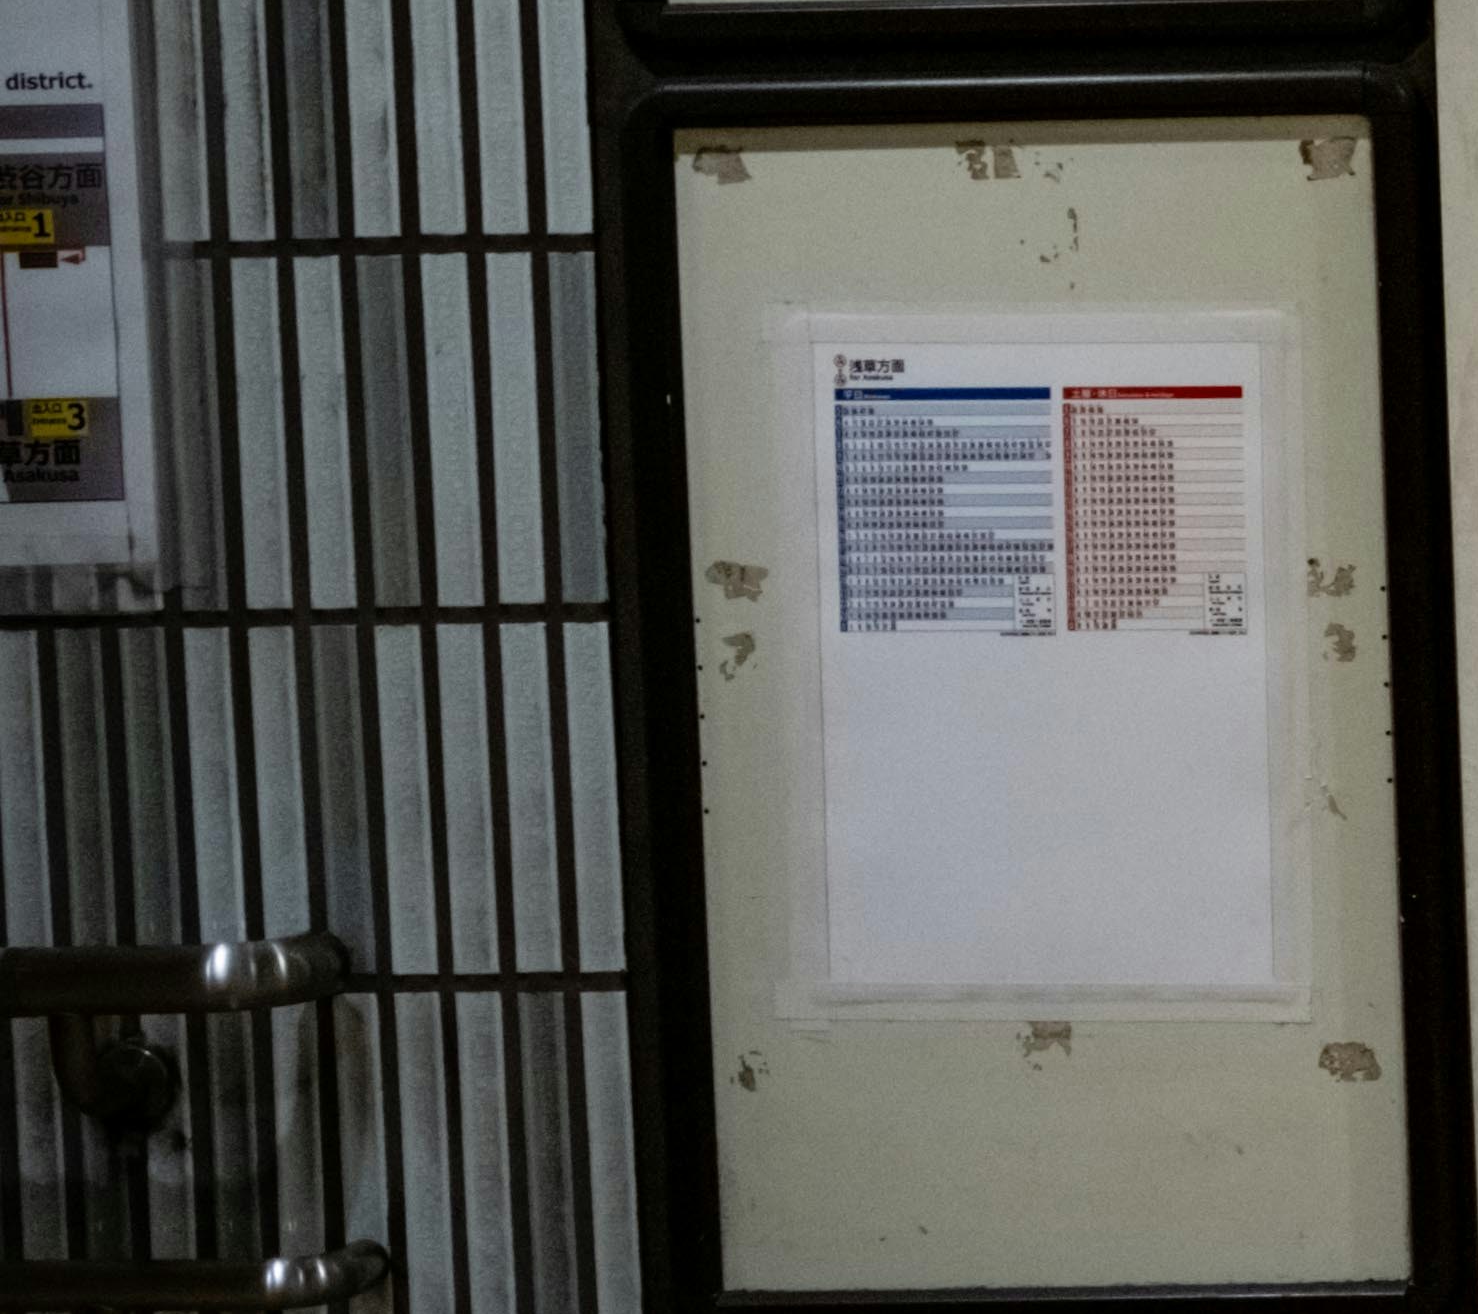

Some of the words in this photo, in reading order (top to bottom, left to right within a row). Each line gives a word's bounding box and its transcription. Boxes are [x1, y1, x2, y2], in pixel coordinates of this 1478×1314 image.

[6, 72, 93, 91] district.
[33, 212, 50, 237] 1
[850, 359, 904, 373] 浅草方面
[67, 403, 85, 431] 3
[4, 468, 80, 483] Asakusa
